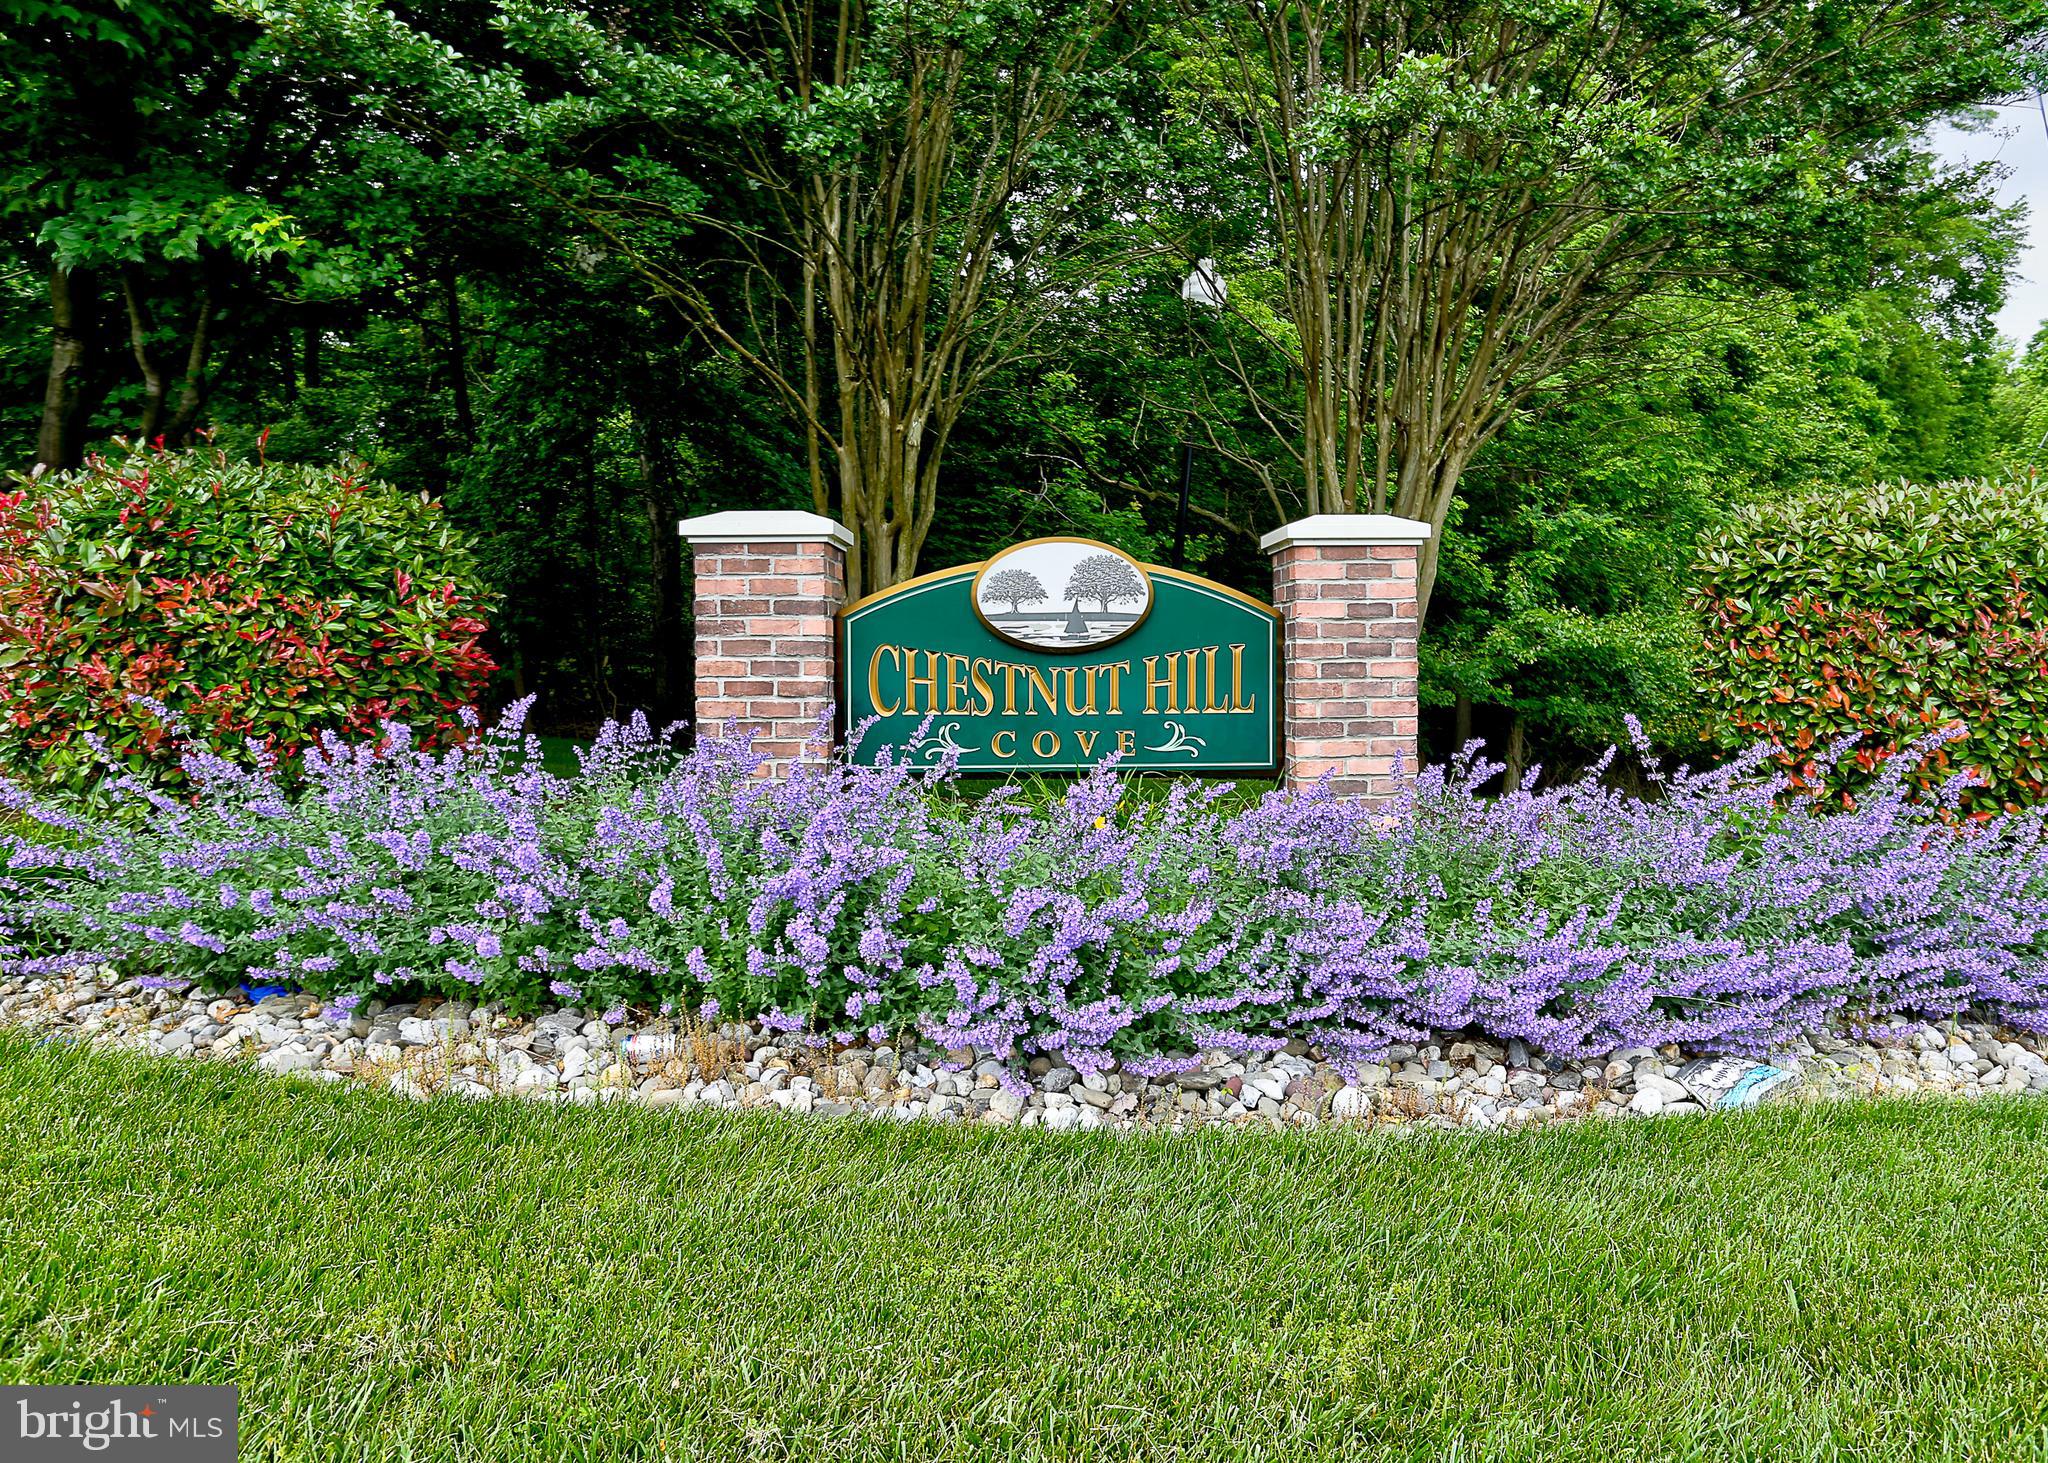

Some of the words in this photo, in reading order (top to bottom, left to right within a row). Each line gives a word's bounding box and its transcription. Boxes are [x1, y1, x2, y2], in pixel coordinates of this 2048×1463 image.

[868, 644, 1130, 717] CHESTNUT
[1142, 643, 1256, 715] HILL
[991, 730, 1136, 758] COVE
